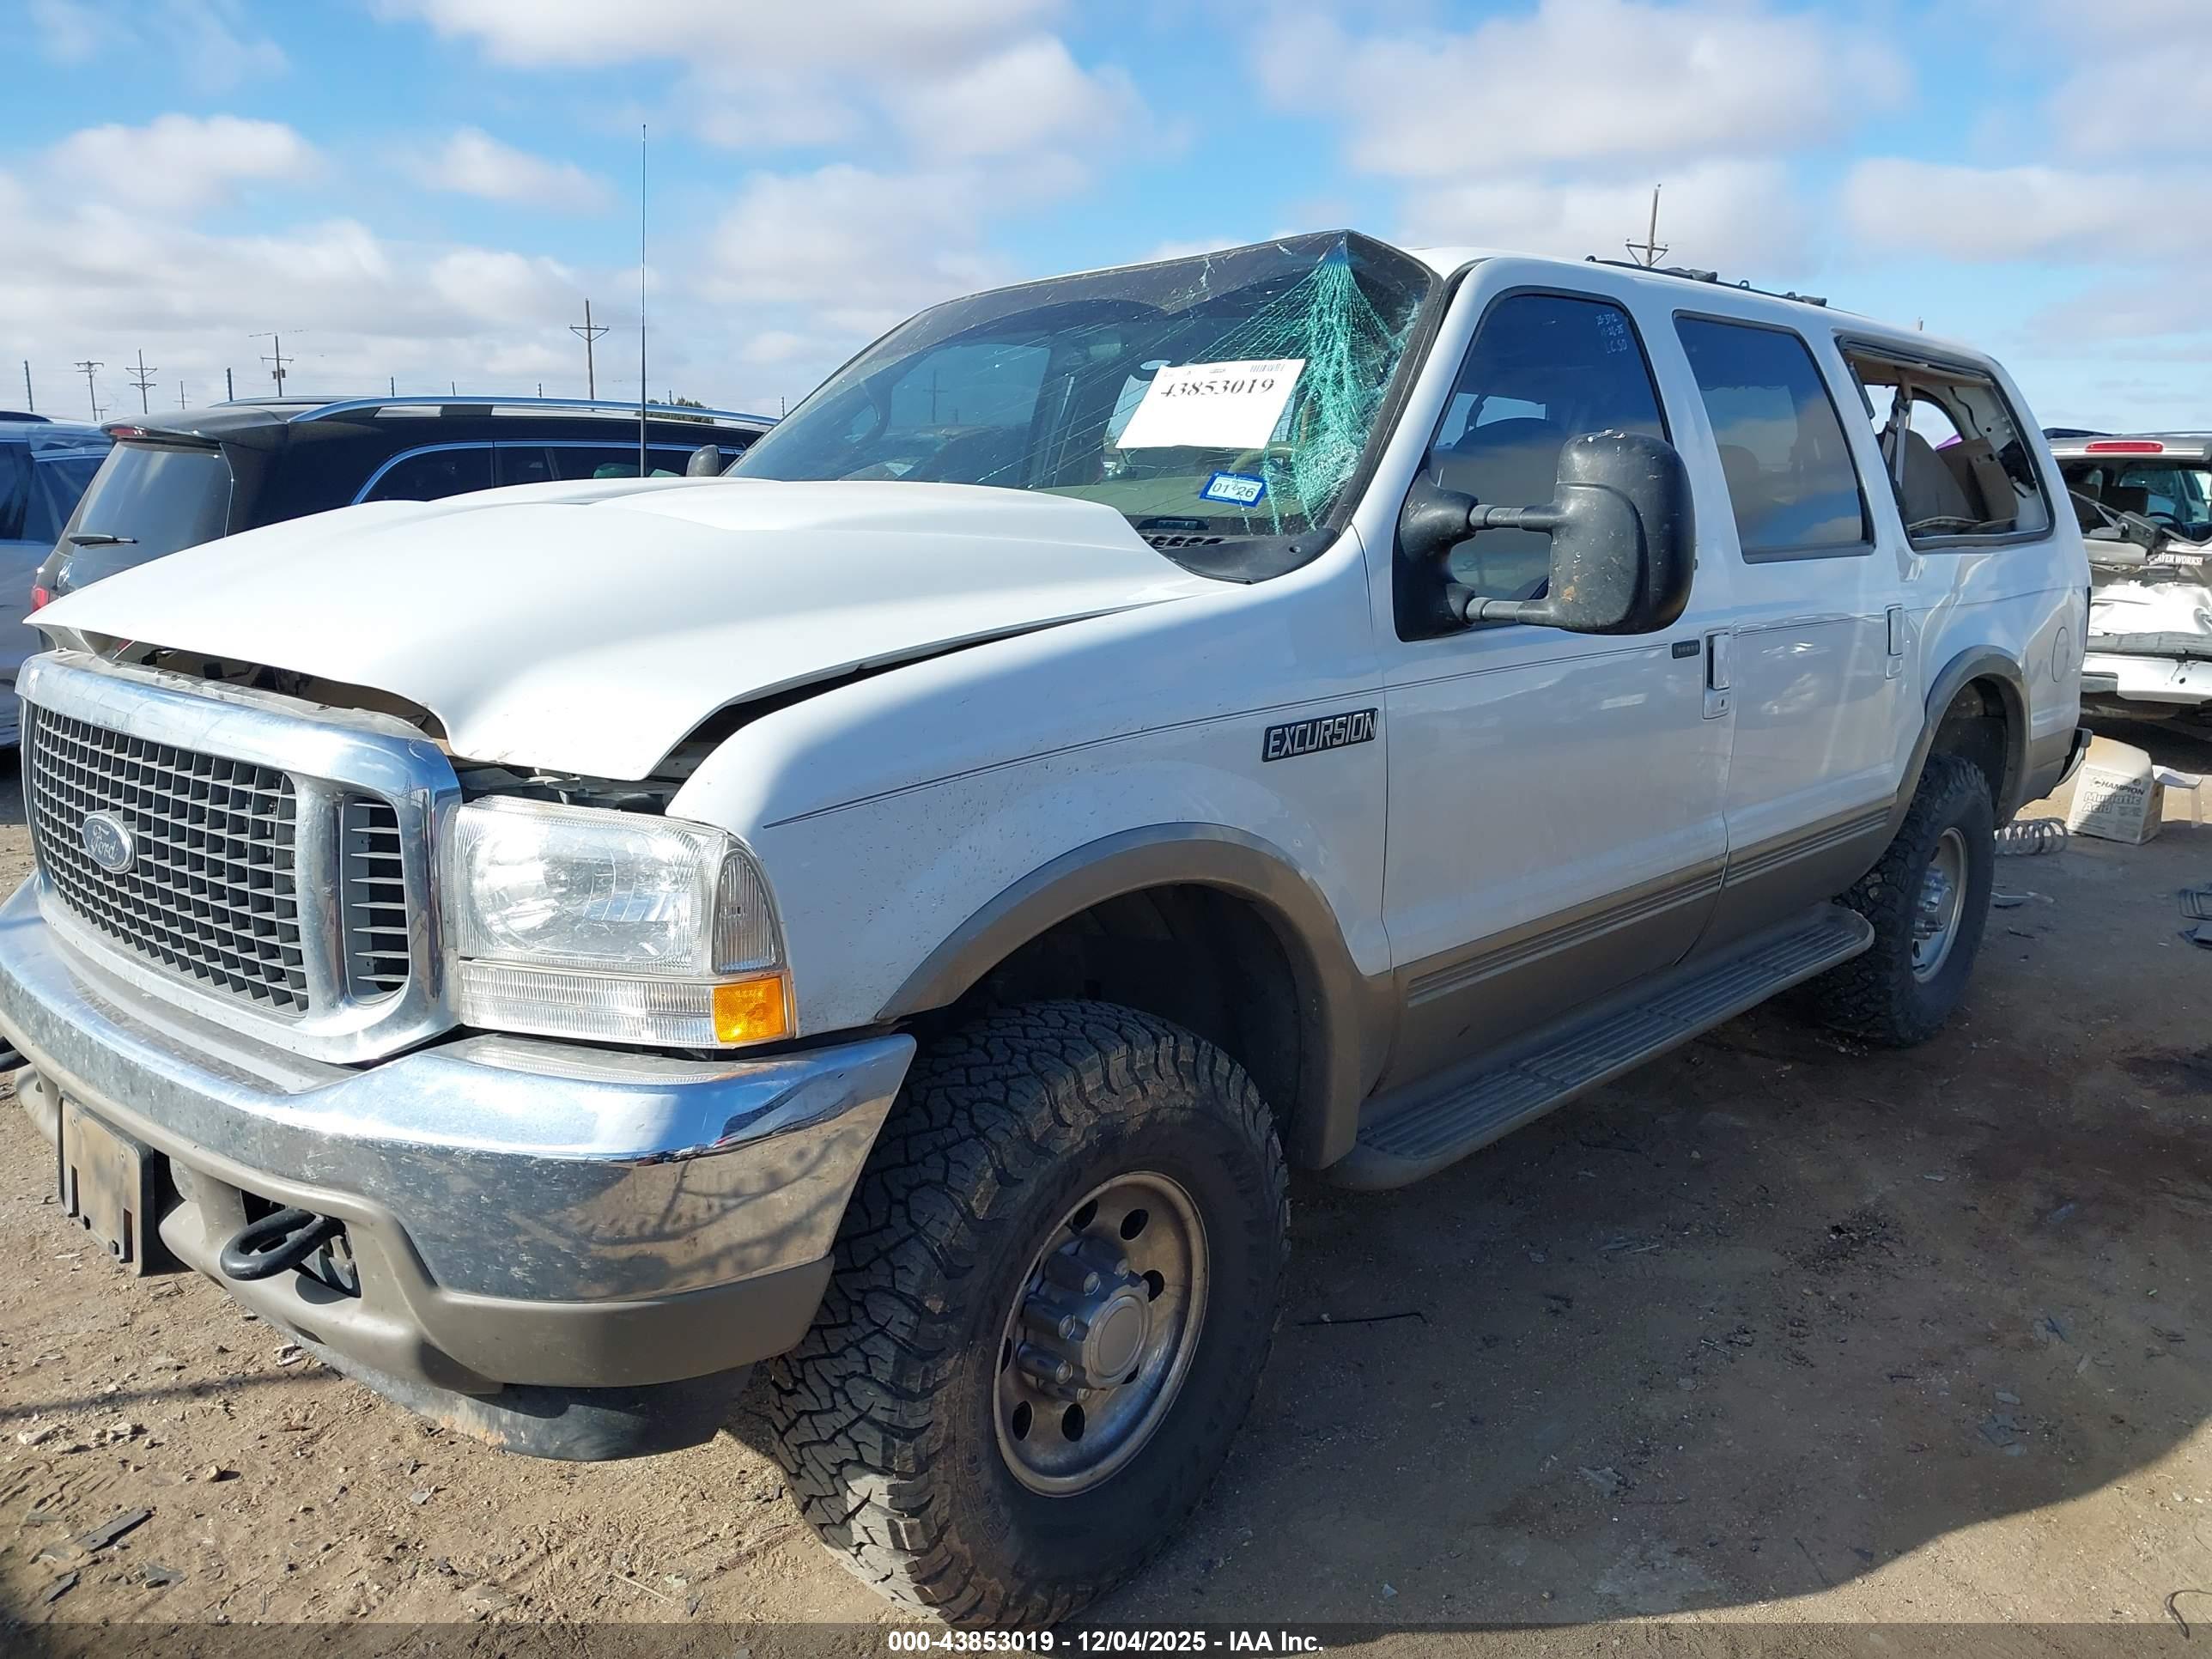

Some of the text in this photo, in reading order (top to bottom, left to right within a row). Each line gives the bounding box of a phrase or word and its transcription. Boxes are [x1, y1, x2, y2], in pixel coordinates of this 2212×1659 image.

[1160, 378, 1275, 398] 43853019
[1212, 483, 1256, 498] 01 26
[1267, 710, 1379, 758] EXCURSION
[2083, 791, 2142, 805] Muriatic
[2081, 802, 2112, 813] Acid
[90, 825, 118, 860] Ford
